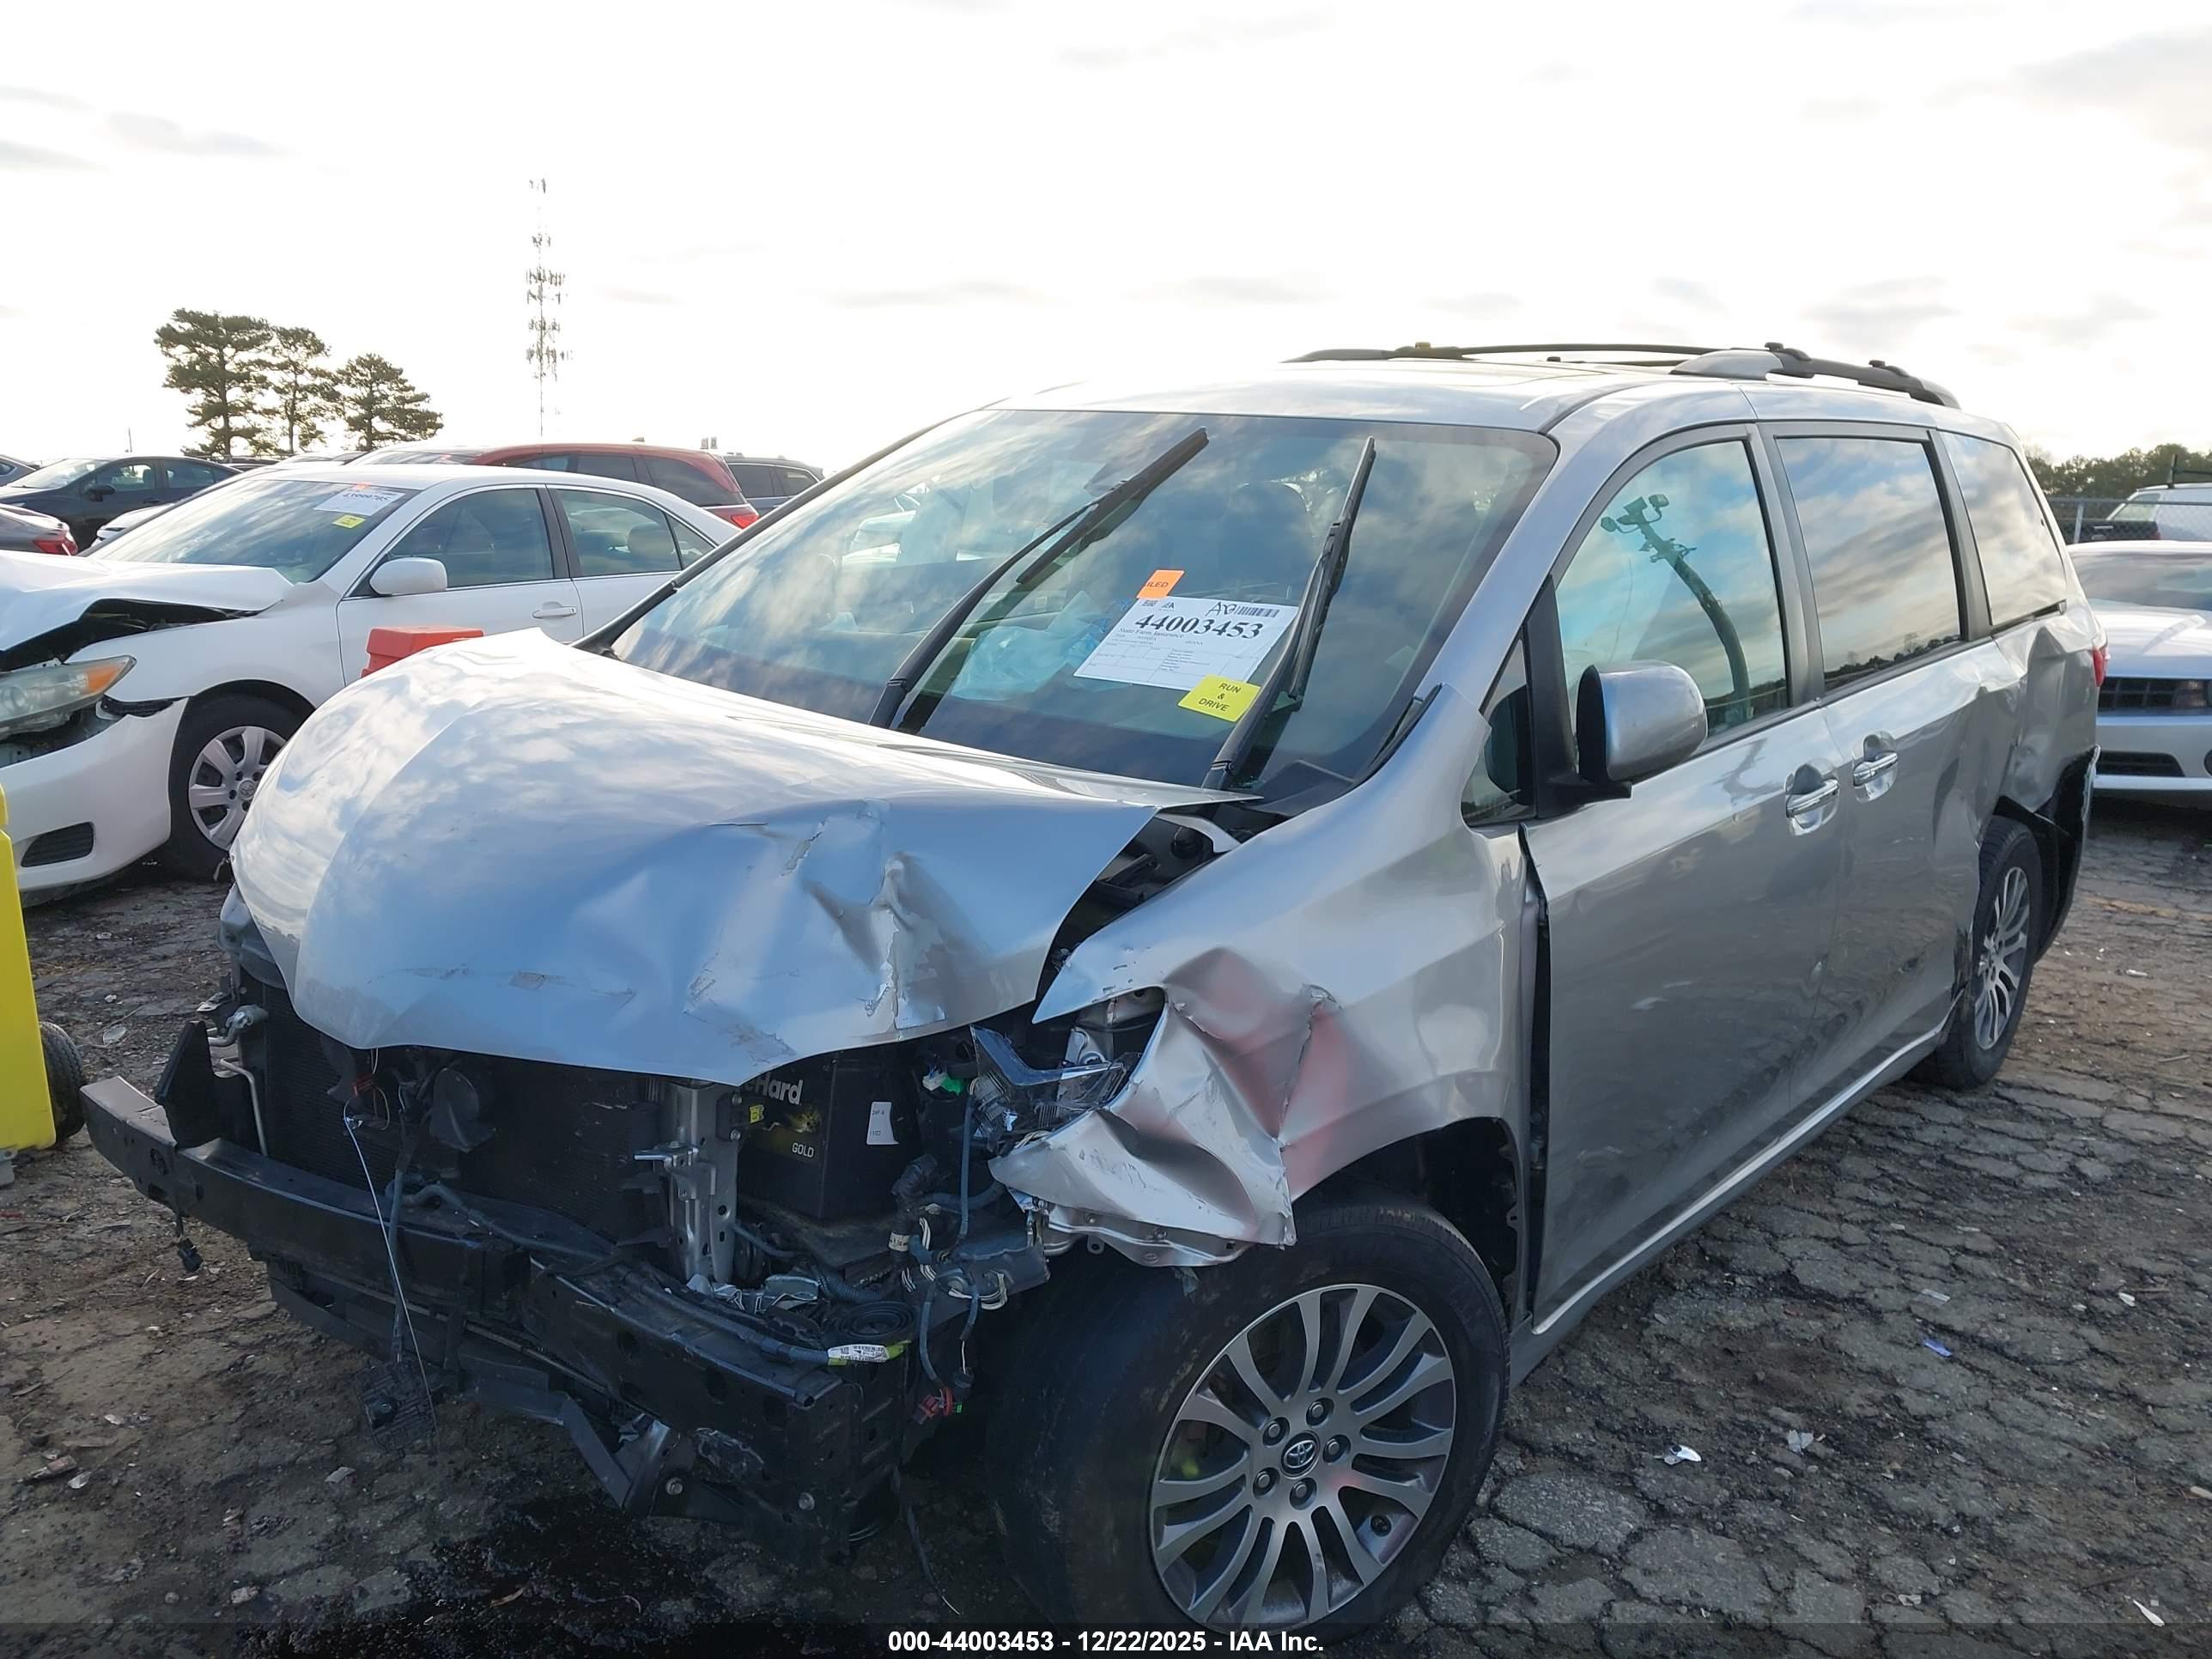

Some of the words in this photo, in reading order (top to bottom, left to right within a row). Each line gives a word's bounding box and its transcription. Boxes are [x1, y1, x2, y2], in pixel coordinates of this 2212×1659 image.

[1135, 614, 1264, 639] 44003453
[1218, 683, 1242, 693] RUN
[1198, 698, 1231, 712] DRIVE
[792, 1142, 815, 1158] GOLD
